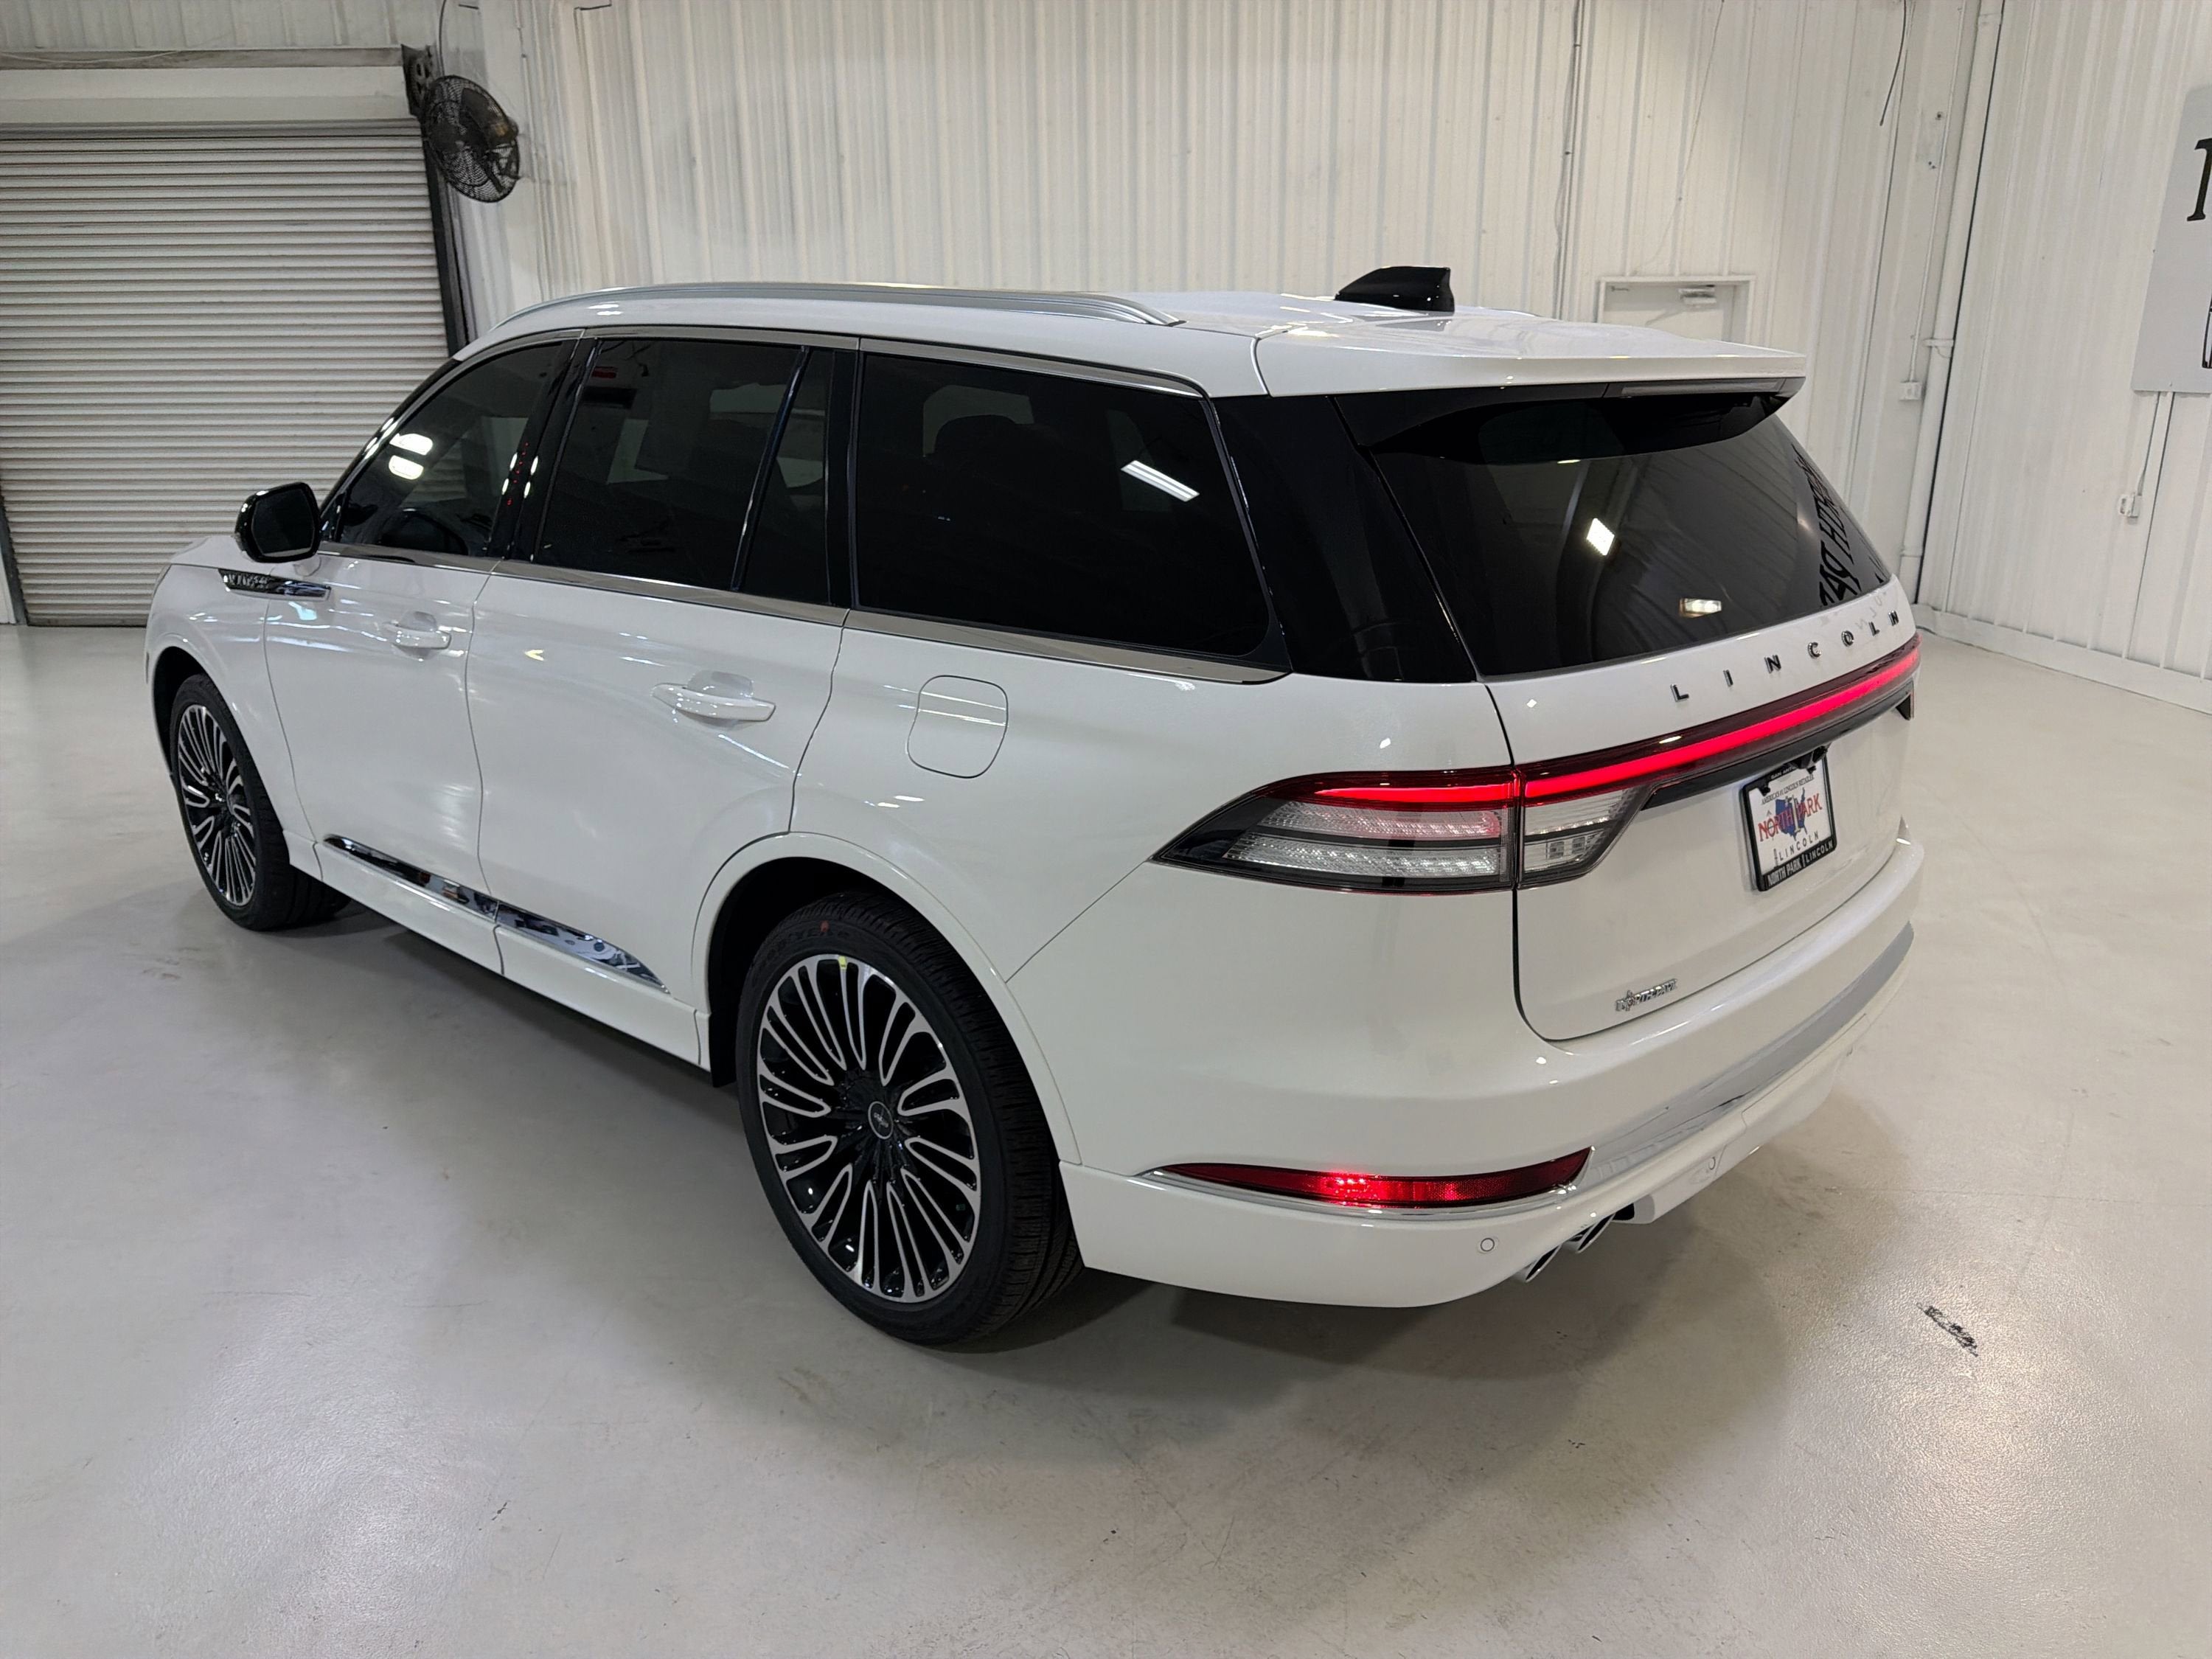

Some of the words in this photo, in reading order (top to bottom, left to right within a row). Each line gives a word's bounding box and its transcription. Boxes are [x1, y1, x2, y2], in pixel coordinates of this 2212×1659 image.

[1670, 610, 1899, 703] LINCOLN
[1758, 807, 1793, 842] NORTH
[1797, 793, 1823, 821] PARK
[1778, 831, 1820, 861] LINCOLN
[1786, 857, 1802, 877] PARK
[1806, 841, 1833, 862] LINCOLN
